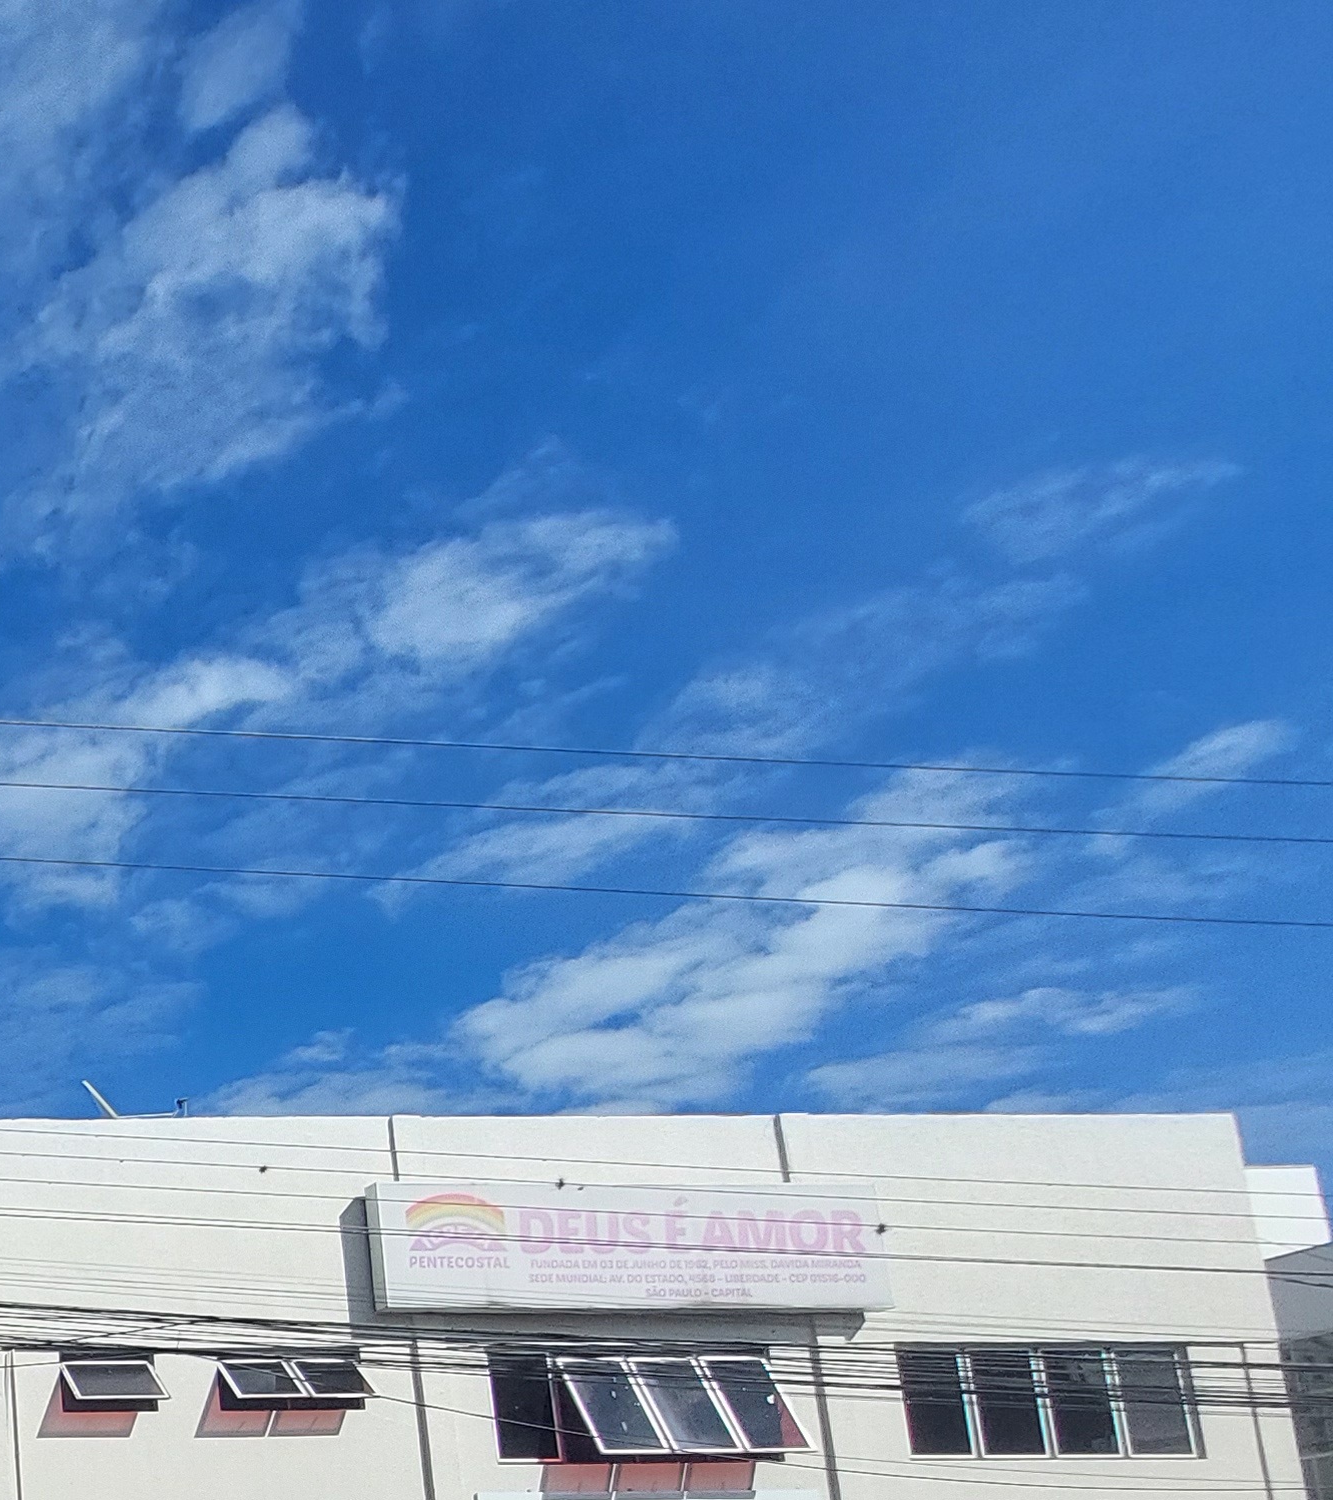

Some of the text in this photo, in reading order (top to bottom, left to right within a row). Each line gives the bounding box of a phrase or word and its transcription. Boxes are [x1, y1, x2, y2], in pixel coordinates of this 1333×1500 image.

[517, 1196, 867, 1256] DEUS É AMOR
[408, 1255, 510, 1269] PENTECOSTAL
